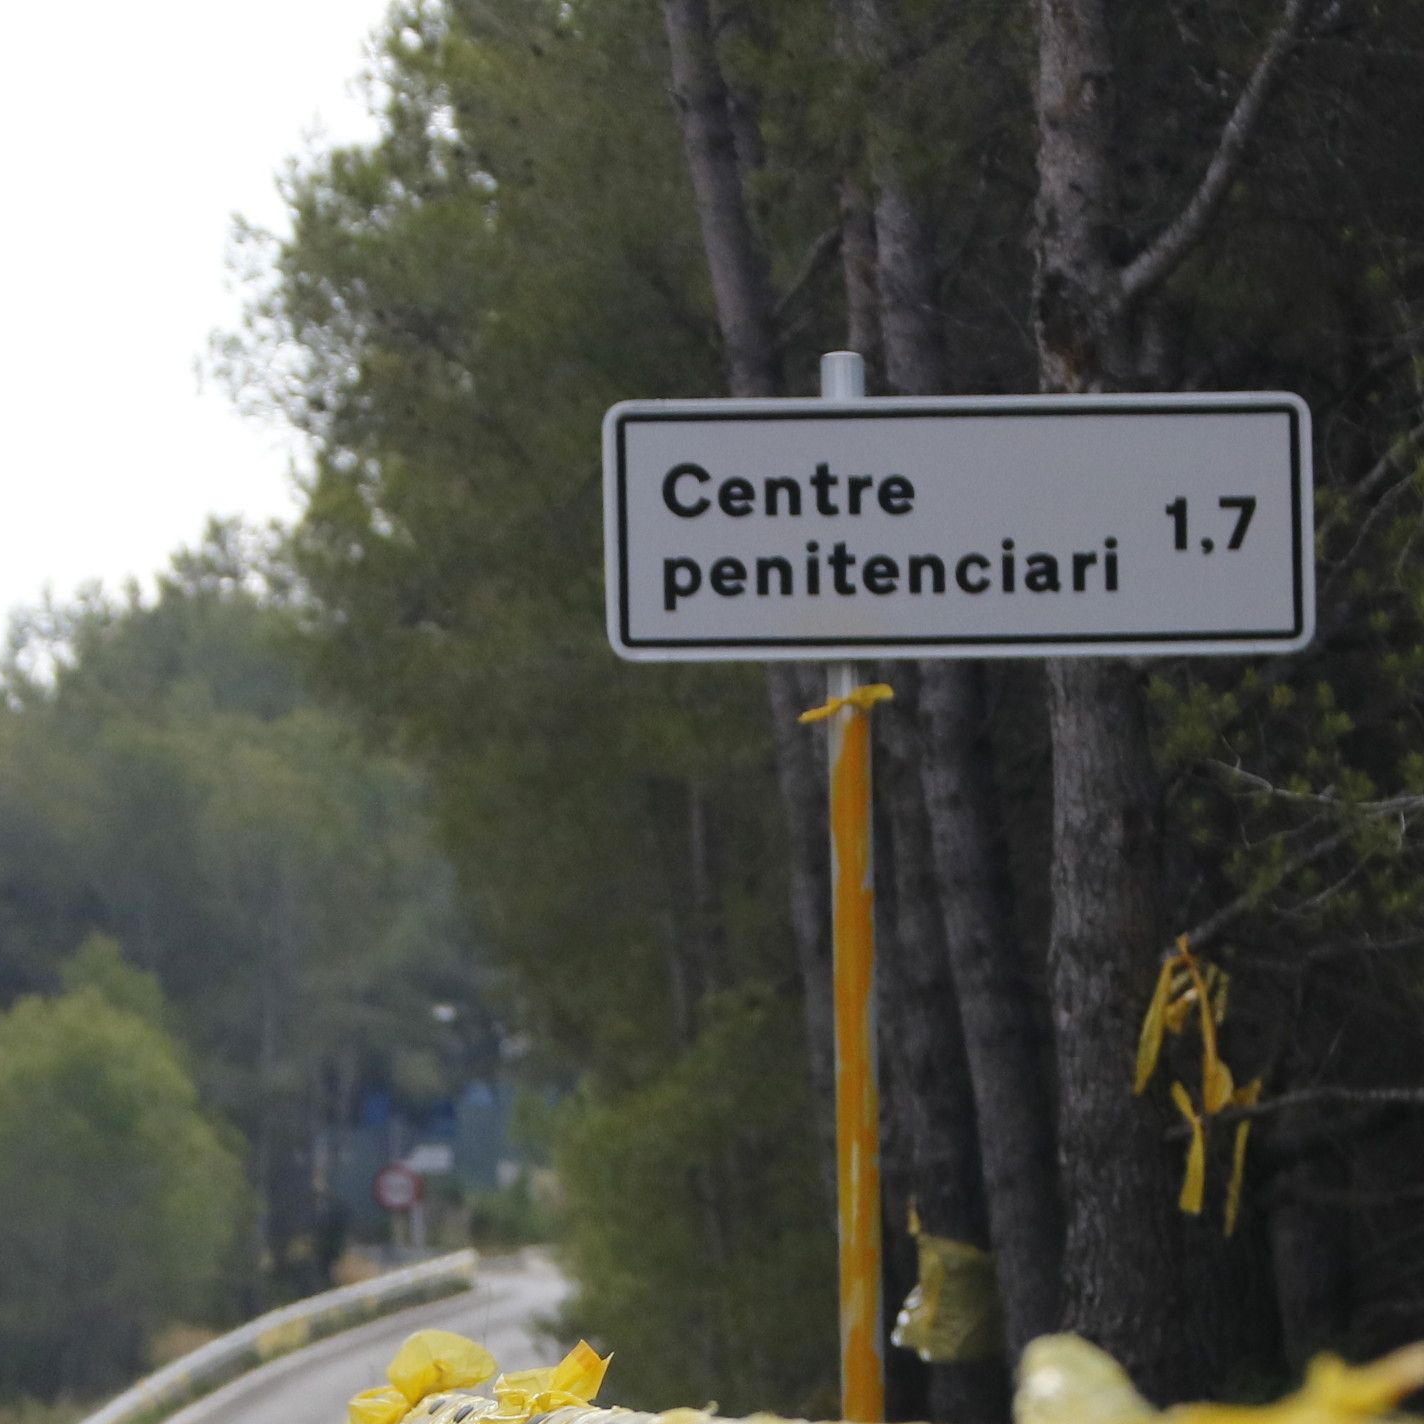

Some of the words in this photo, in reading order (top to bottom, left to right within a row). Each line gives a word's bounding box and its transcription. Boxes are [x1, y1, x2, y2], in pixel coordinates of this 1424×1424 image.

[660, 461, 917, 519] Centre
[1163, 494, 1259, 557] 1,7
[662, 535, 1120, 613] penitenciari
